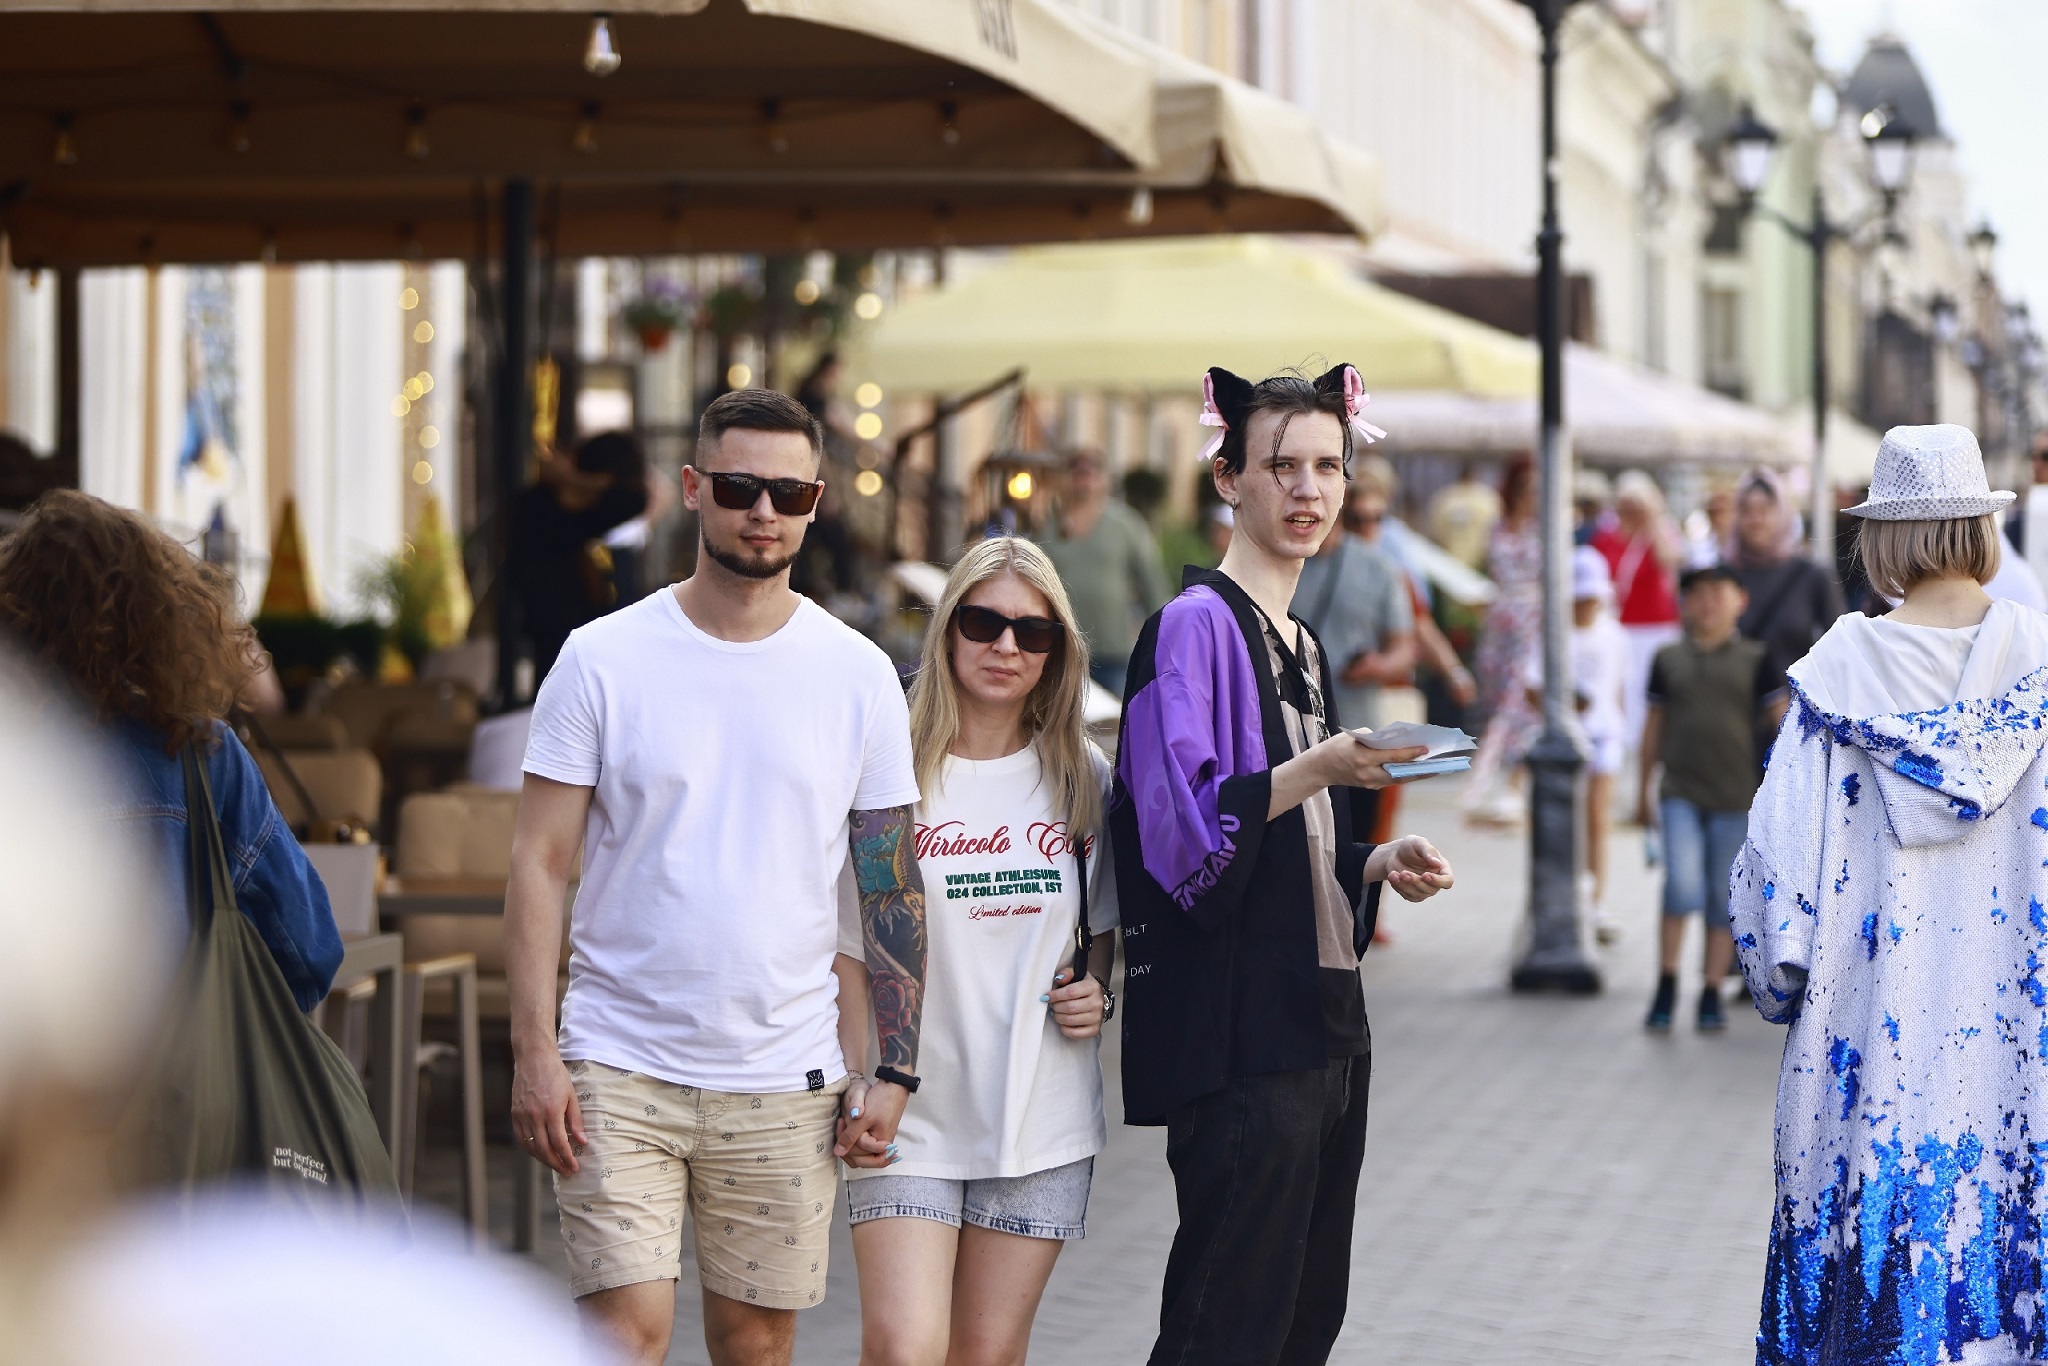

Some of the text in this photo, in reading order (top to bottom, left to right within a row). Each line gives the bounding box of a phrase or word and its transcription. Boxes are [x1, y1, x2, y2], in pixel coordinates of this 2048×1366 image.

[945, 868, 1062, 886] VINTAGE ATHLEISURE
[946, 887, 970, 900] 024
[972, 882, 1043, 898] COLLECTION,
[968, 904, 1043, 921] Limited edition
[1130, 963, 1152, 978] DAY
[272, 1154, 292, 1168] but
[274, 1146, 326, 1171] not perfect
